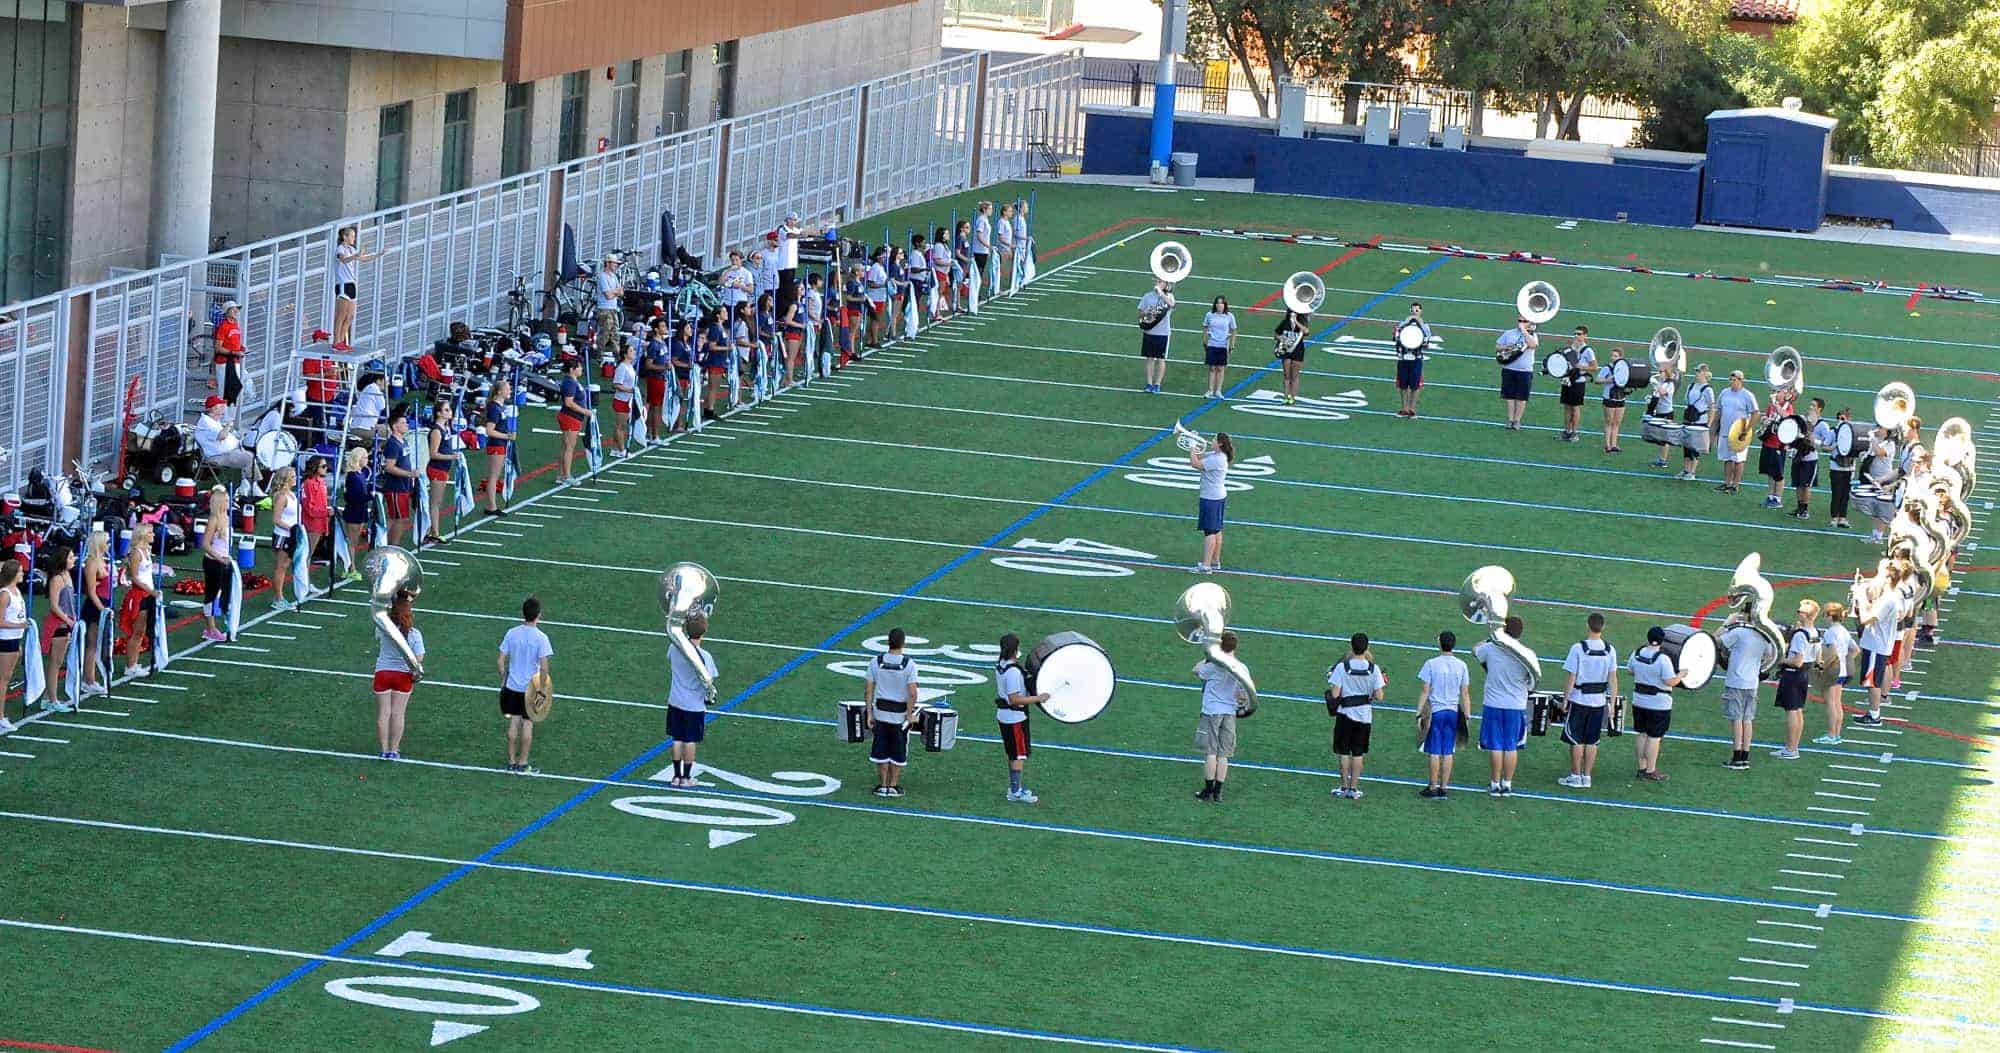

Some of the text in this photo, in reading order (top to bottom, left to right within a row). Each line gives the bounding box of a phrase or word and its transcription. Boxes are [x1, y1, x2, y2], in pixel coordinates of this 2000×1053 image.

[1230, 389, 1368, 420] 20
[990, 537, 1158, 577] 40
[611, 762, 842, 827] 20
[324, 931, 594, 1015] 10
